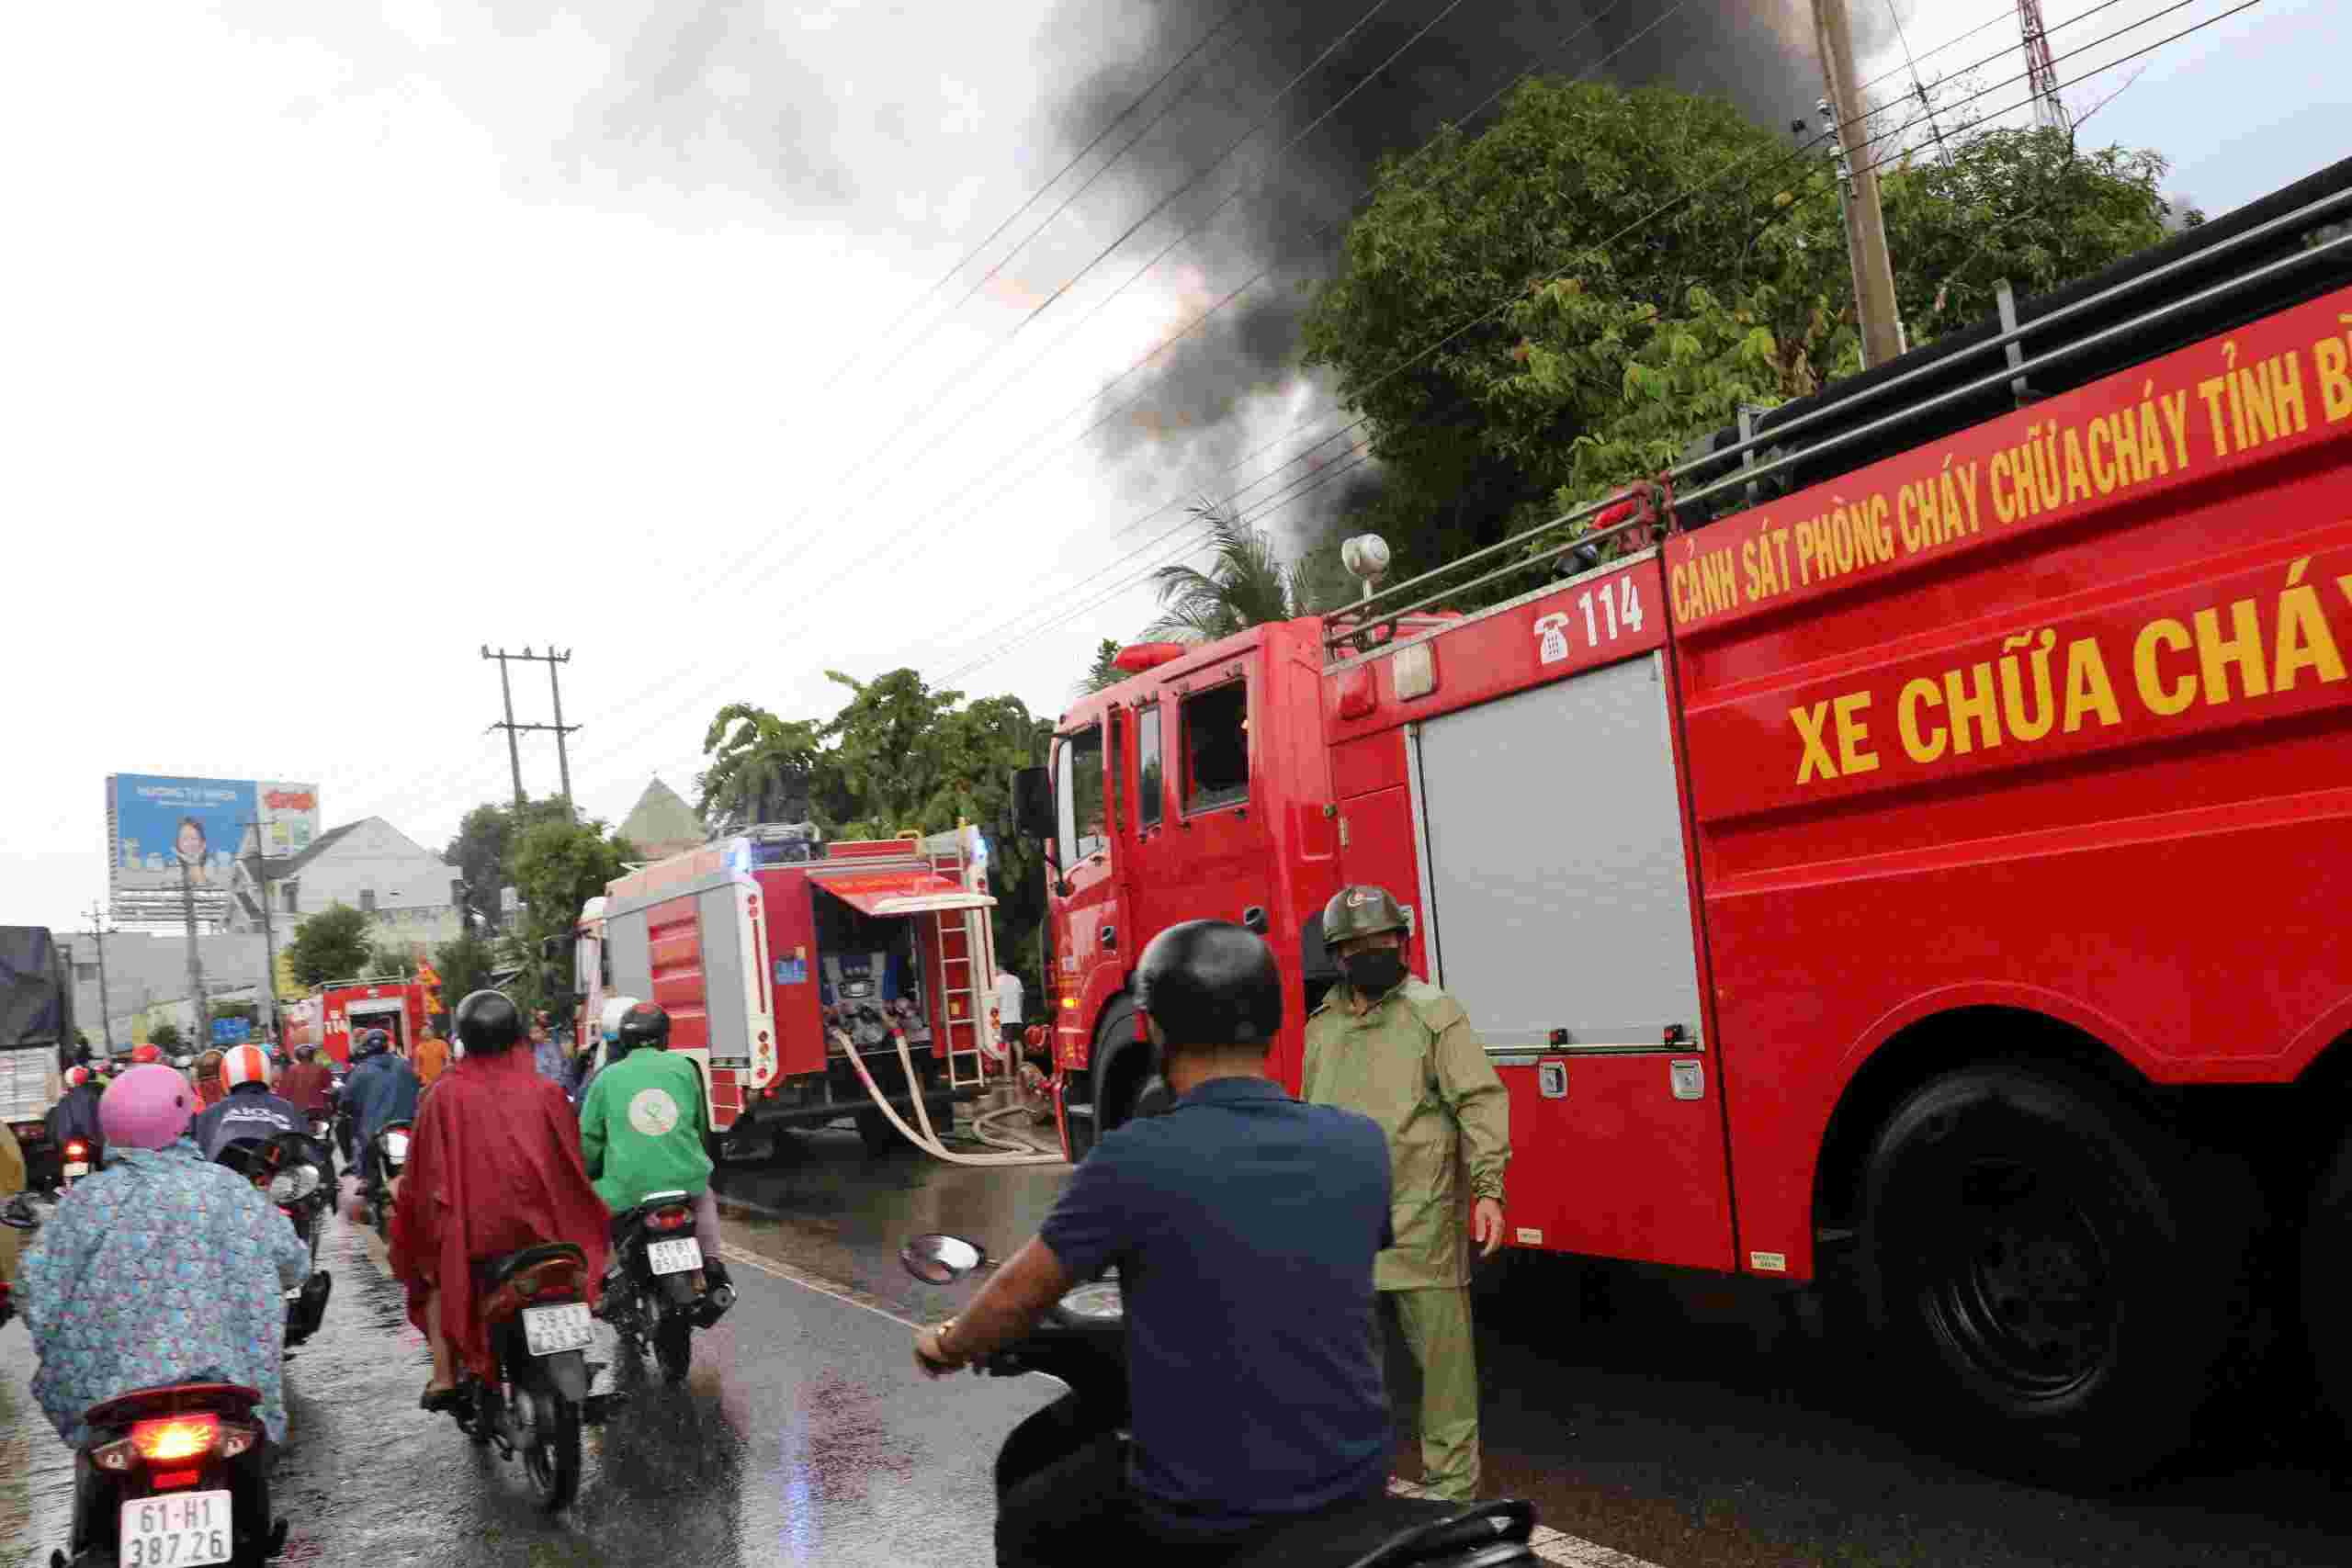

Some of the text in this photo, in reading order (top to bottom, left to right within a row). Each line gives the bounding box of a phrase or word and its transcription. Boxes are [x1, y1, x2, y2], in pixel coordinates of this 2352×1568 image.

[1672, 536, 1738, 624] CẢNH
[1742, 515, 1791, 602] SÁT
[1794, 495, 1896, 587] PHÒNG
[1898, 453, 1979, 553] CHÁY
[2197, 339, 2308, 456] TỈNH
[1578, 575, 1643, 647] 114
[1789, 558, 2352, 784] XE CHỮA CHÁ
[125, 1529, 227, 1567] 387.26
[141, 1499, 210, 1533] 61-H1
